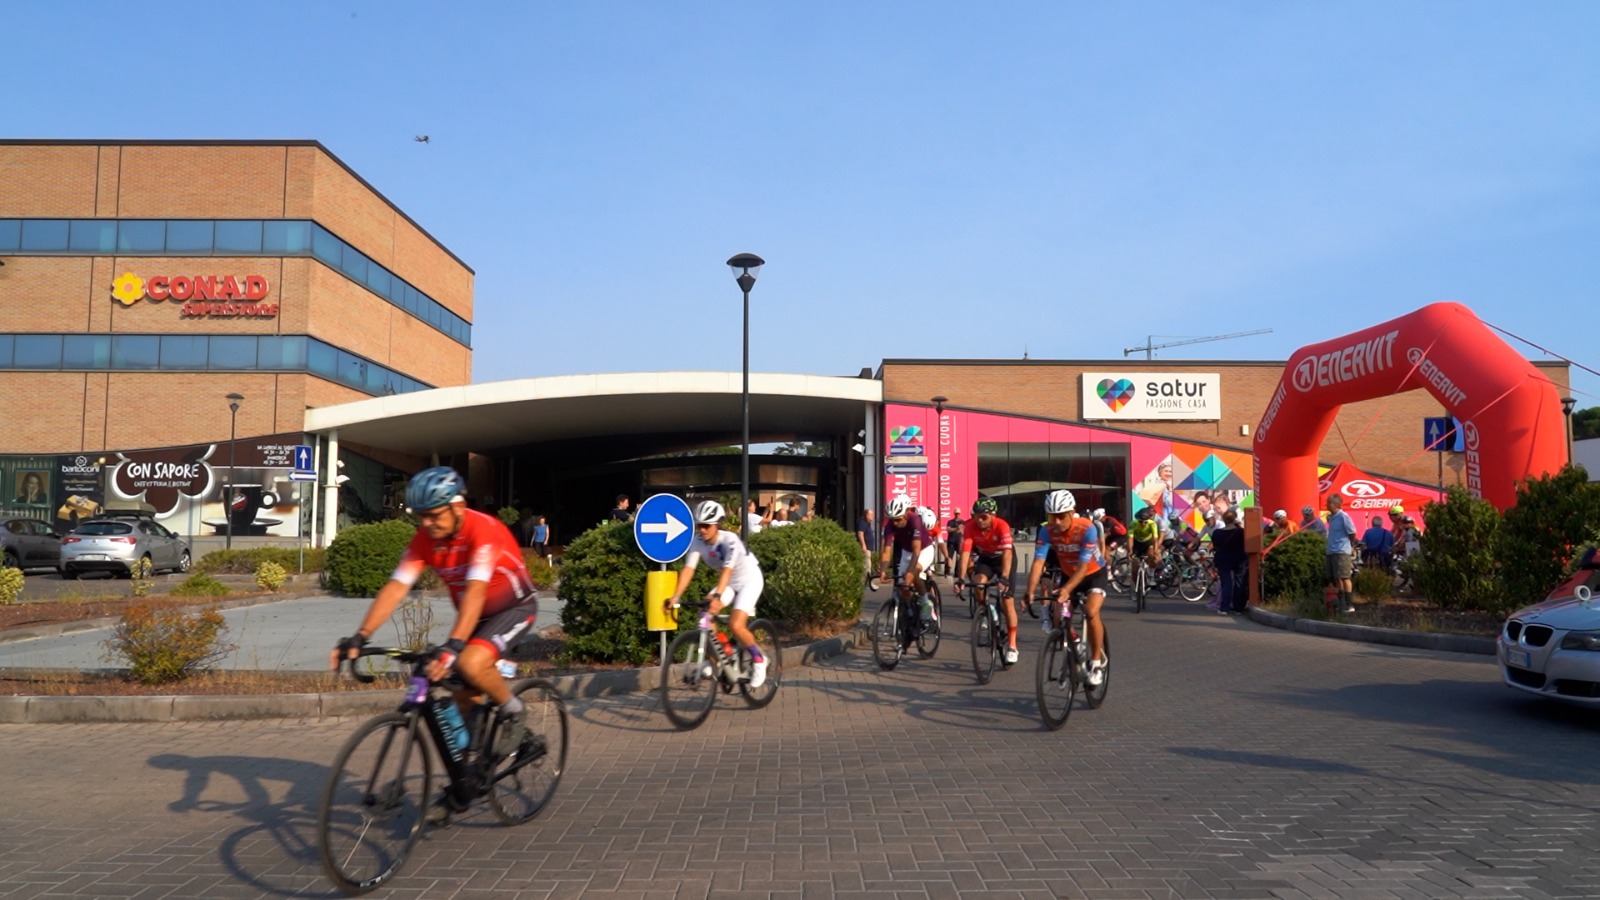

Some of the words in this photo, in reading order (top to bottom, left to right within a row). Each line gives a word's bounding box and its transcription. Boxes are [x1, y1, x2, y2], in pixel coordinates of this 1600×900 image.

[146, 275, 269, 300] CONAD
[181, 303, 279, 316] SUPERSTORE
[1317, 330, 1399, 387] ENERVIT
[1146, 379, 1207, 397] satur
[1419, 359, 1467, 406] ENERVIT
[1146, 399, 1182, 408] PASSIONE
[1188, 399, 1207, 408] CASA
[940, 415, 951, 446] CUORE
[940, 452, 951, 469] DEL
[127, 462, 151, 478] CON
[153, 462, 200, 478] SAPORE
[940, 475, 951, 518] NEGOZIO
[1364, 498, 1403, 509] ENERVIT
